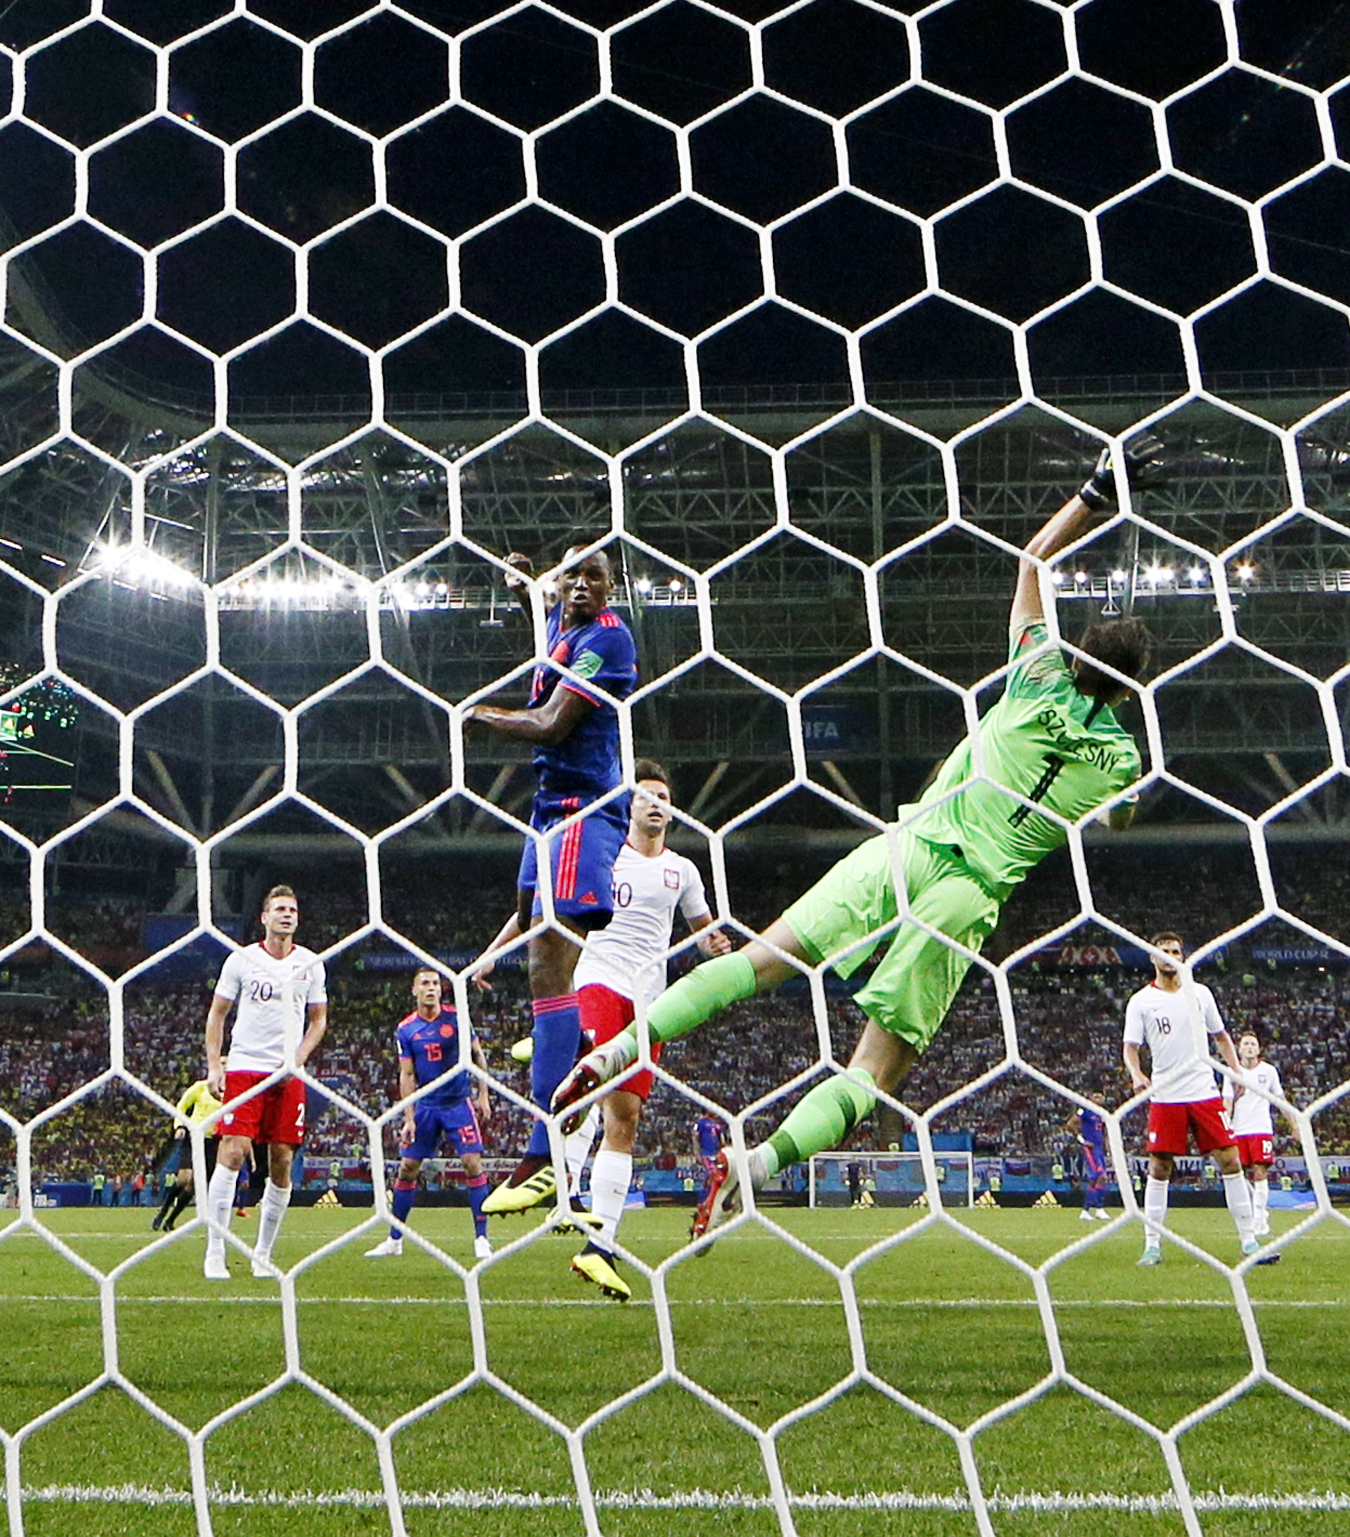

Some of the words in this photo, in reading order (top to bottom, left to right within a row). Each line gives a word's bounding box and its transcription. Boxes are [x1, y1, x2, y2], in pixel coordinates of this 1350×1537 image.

[1008, 751, 1065, 828] 1
[250, 980, 273, 1002] 20
[1155, 1016, 1171, 1035] 18
[424, 1043, 443, 1062] 15
[458, 1125, 477, 1145] 15
[1262, 1140, 1273, 1154] 19
